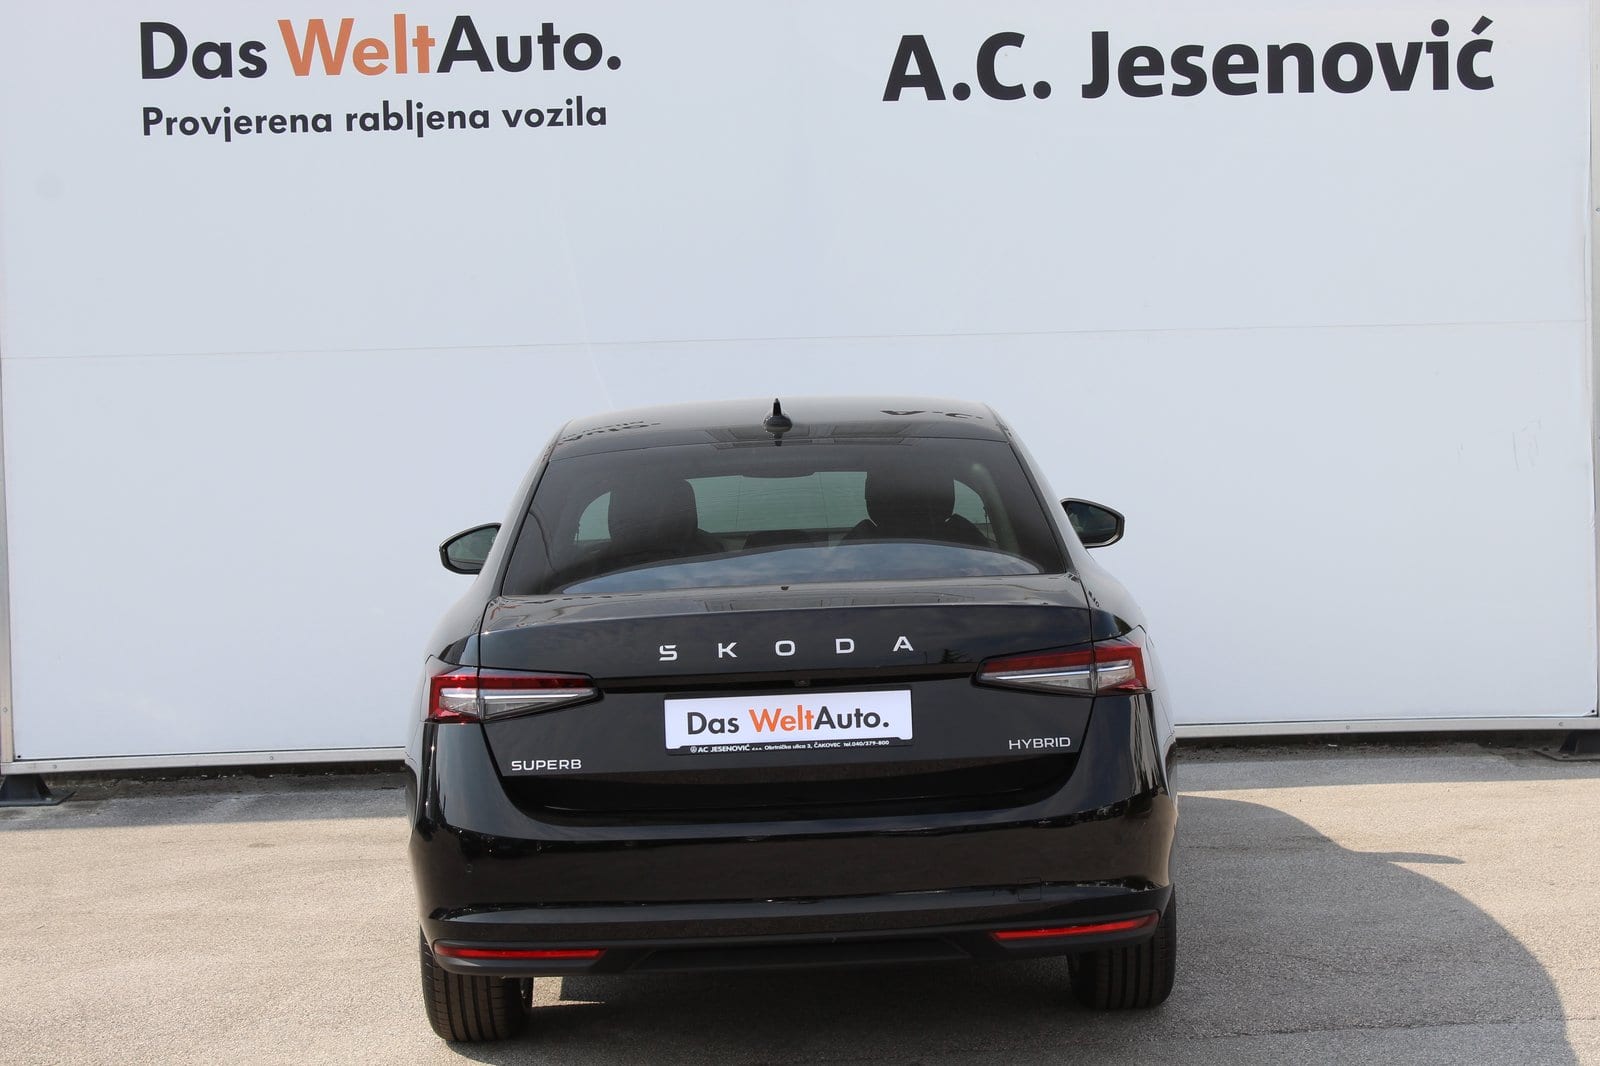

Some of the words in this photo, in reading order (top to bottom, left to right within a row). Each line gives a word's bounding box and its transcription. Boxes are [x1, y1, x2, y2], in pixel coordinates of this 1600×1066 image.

[140, 22, 267, 79] Das
[278, 14, 622, 77] WeltAuto.
[883, 32, 1051, 101] A.C.
[1081, 16, 1495, 98] Jesenović
[143, 107, 332, 142] Provjerena
[346, 100, 490, 138] rabljena
[502, 96, 607, 128] vozila
[687, 711, 740, 735] Das
[749, 705, 890, 733] WeltAuto.
[813, 741, 841, 749] ČAKOVEC
[1008, 737, 1071, 750] HYBRID
[511, 759, 582, 771] SUPERB
